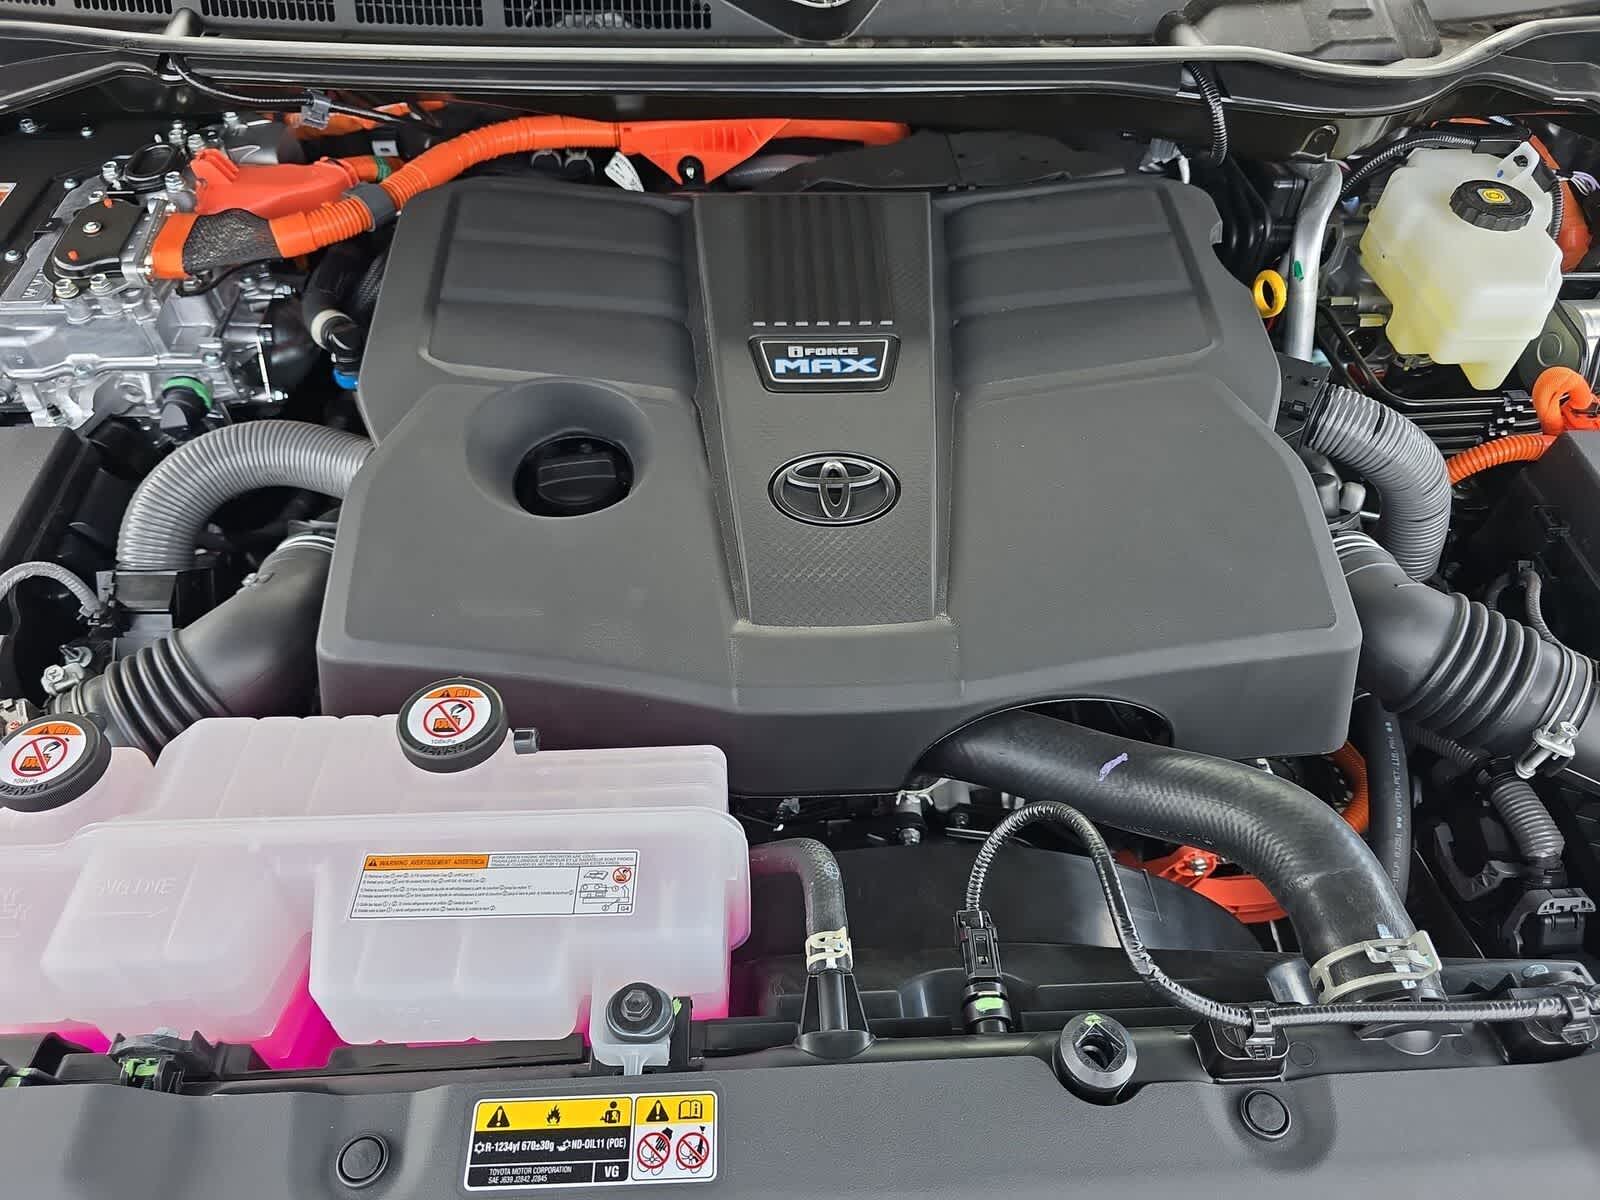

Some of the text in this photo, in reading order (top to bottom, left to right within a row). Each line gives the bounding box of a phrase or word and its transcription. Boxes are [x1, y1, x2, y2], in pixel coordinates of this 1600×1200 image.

[774, 357, 878, 374] MAX
[485, 1137, 627, 1154] R-1234yf 670±30g ND-OIL11 (POE)
[488, 1166, 573, 1176] TOYOTA MOTOR CORPORATION
[604, 1165, 620, 1178] VG
[487, 1176, 500, 1184] SAE
